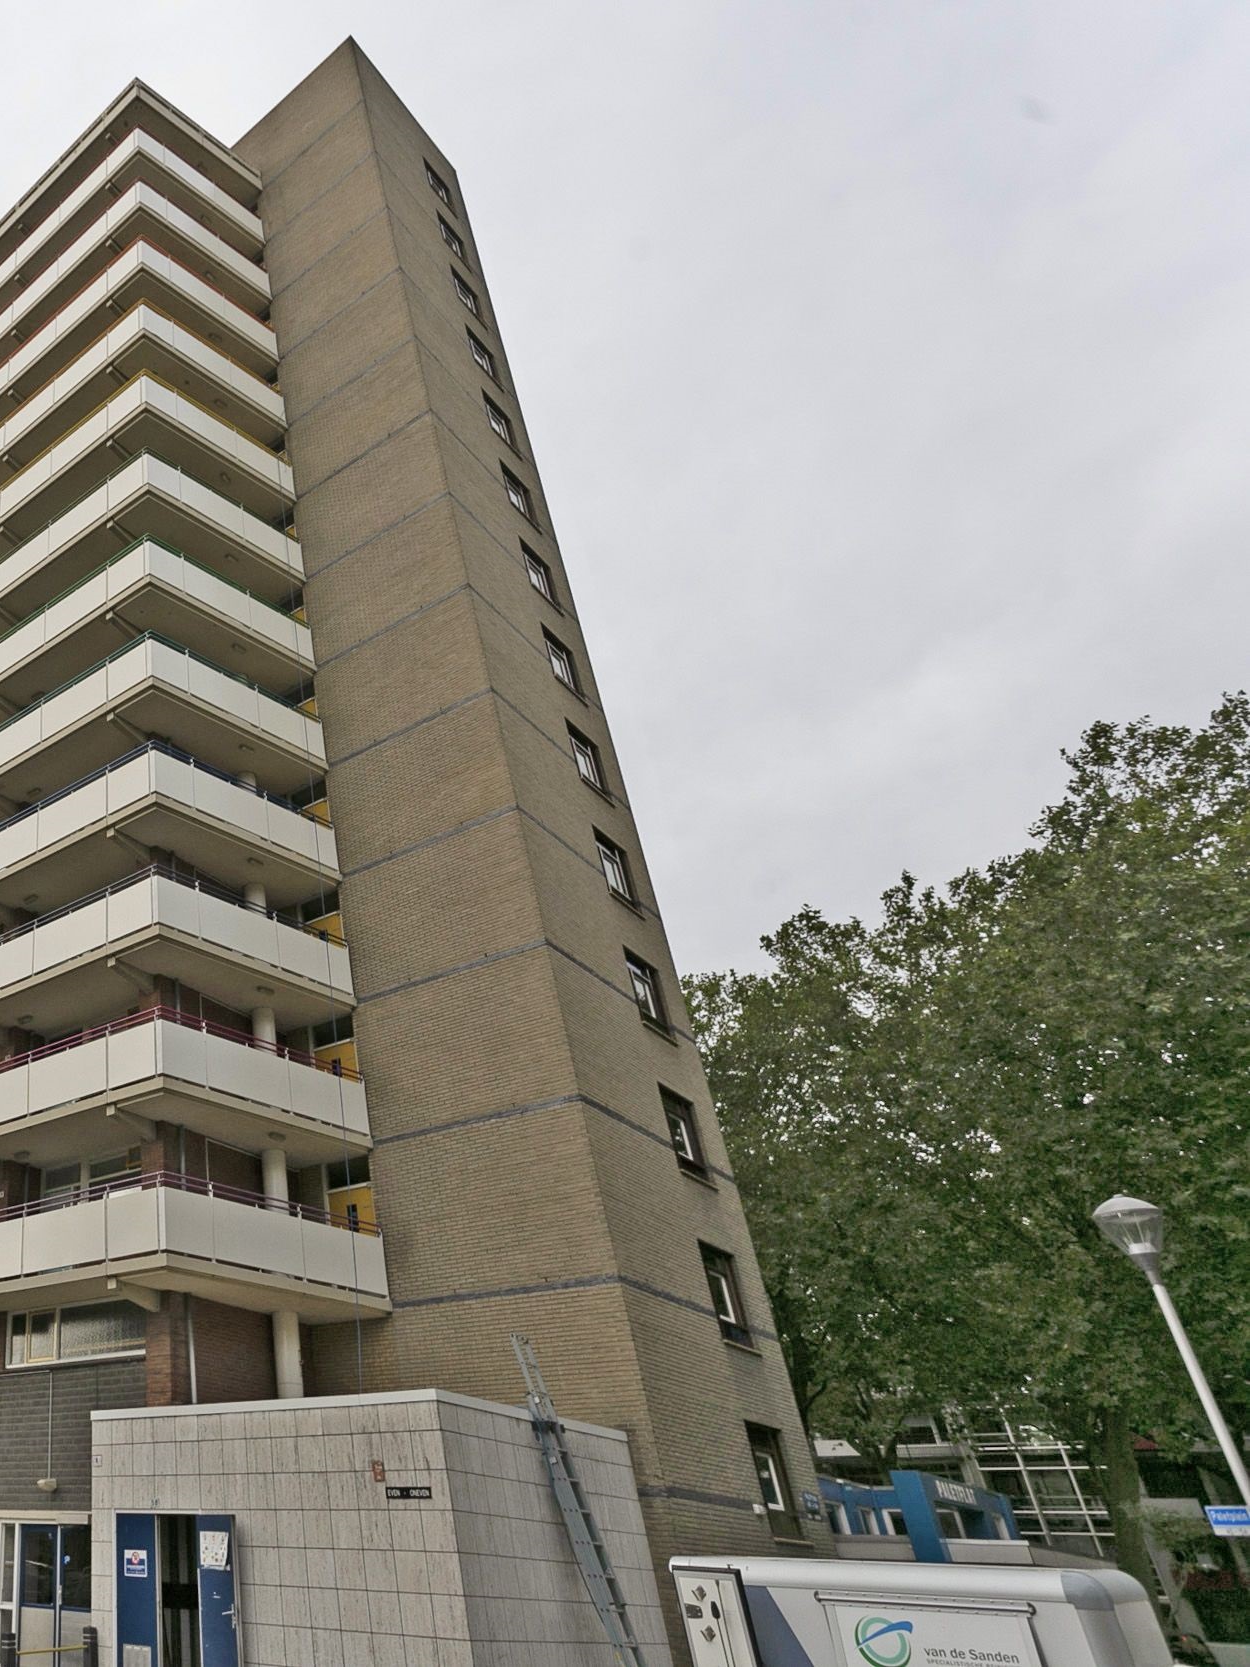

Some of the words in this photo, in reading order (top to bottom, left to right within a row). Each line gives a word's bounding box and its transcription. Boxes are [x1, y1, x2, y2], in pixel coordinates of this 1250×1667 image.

[387, 1489, 401, 1497] EVEN
[409, 1489, 430, 1497] ONEVEN
[923, 1648, 947, 1657] van
[950, 1648, 966, 1659] de
[969, 1649, 1020, 1664] Sanden
